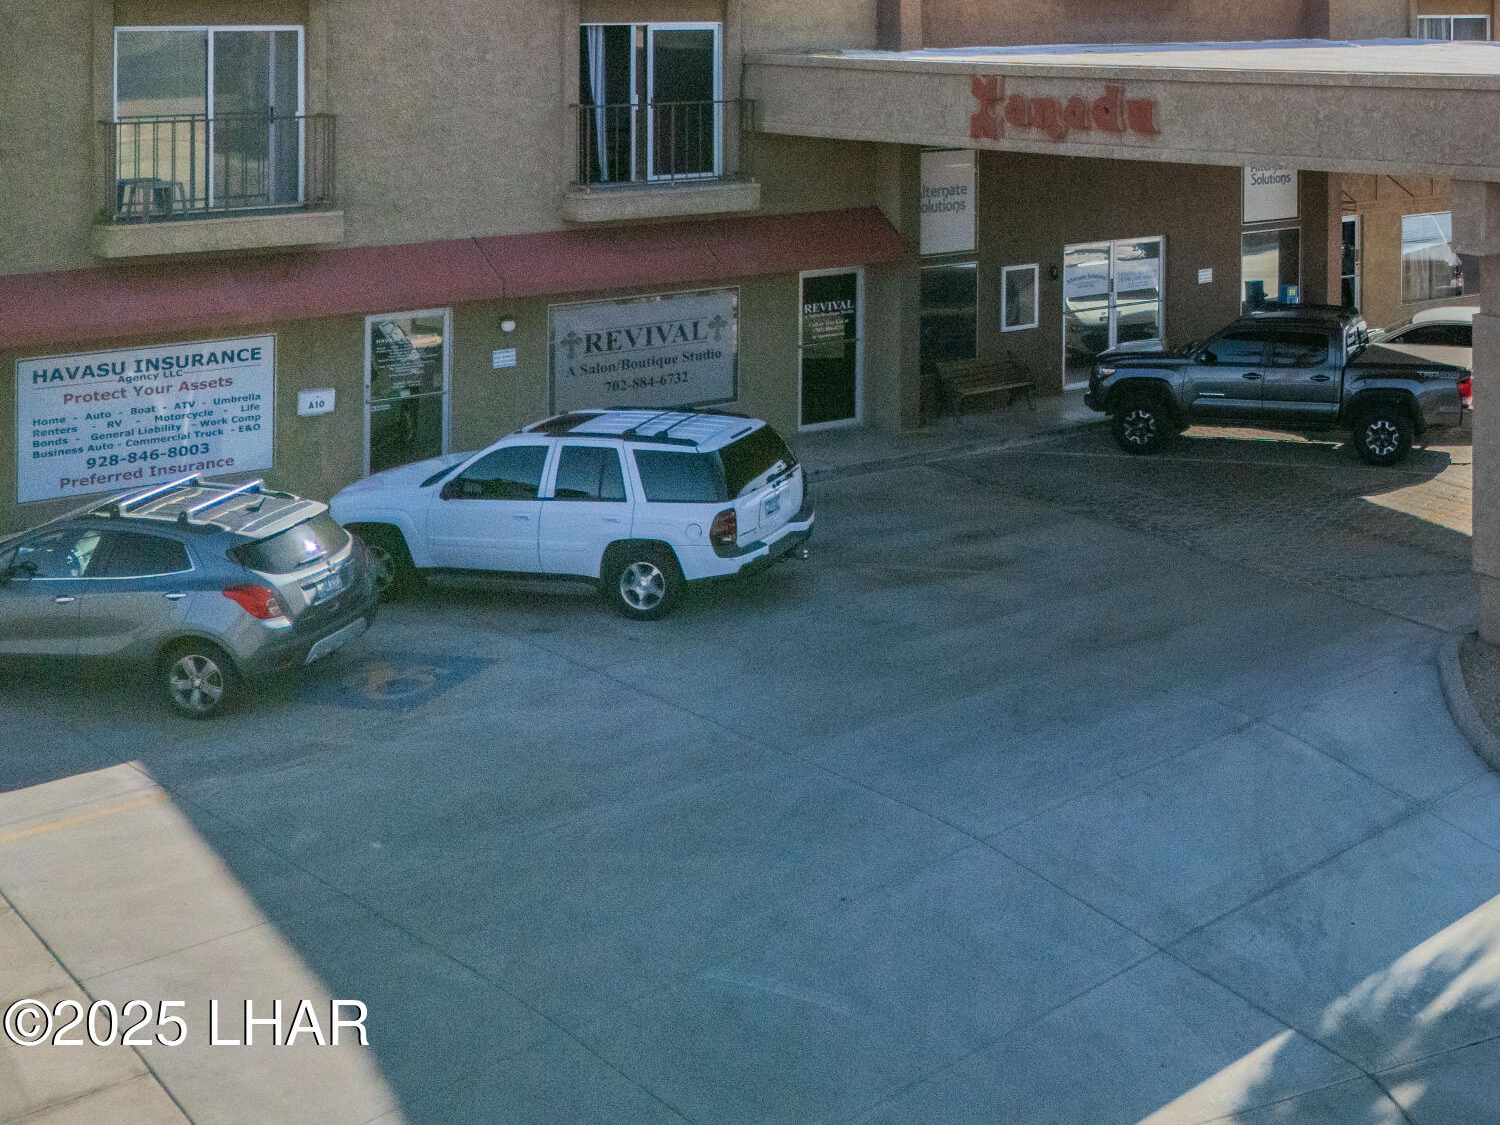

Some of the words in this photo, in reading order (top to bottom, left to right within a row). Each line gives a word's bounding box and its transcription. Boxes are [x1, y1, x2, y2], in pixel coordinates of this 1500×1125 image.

[969, 75, 1160, 143] Xanadu
[920, 184, 968, 199] lternate
[1251, 173, 1291, 186] Solutions
[920, 199, 966, 214] olutions
[804, 300, 855, 314] REVIVAL
[584, 321, 708, 354] REVIVAL
[32, 360, 126, 384] HAVASU
[134, 347, 262, 373] INSURANCE
[580, 355, 679, 375] Salon/Boutique
[682, 348, 722, 363] Studio
[63, 388, 127, 404] Protect
[132, 384, 173, 397] Your
[178, 376, 233, 392] Assets
[117, 373, 159, 383] Agency
[163, 369, 183, 378] LLC
[605, 371, 689, 392] 702-884-6732
[32, 417, 66, 426] Home
[85, 411, 112, 420] Auto
[130, 405, 156, 415] Boat
[174, 400, 196, 410] ATV
[213, 393, 261, 405] Umbrella
[308, 400, 325, 409] A10
[32, 426, 78, 437] Renters
[107, 419, 122, 428] RV
[154, 409, 214, 423] Motorcycle
[241, 404, 260, 412] Life
[32, 437, 69, 448] Bonds
[91, 428, 134, 441] General
[138, 423, 182, 435] Liability
[200, 417, 228, 427] Work
[231, 414, 261, 425] Comp
[32, 445, 84, 459] Business
[87, 443, 114, 452] Auto
[125, 431, 191, 447] Commercial
[194, 428, 224, 439] Truck
[238, 423, 261, 433] E&O
[86, 442, 210, 470] 928-846-8003
[59, 467, 143, 490] Preferred
[149, 457, 235, 477] Insurance
